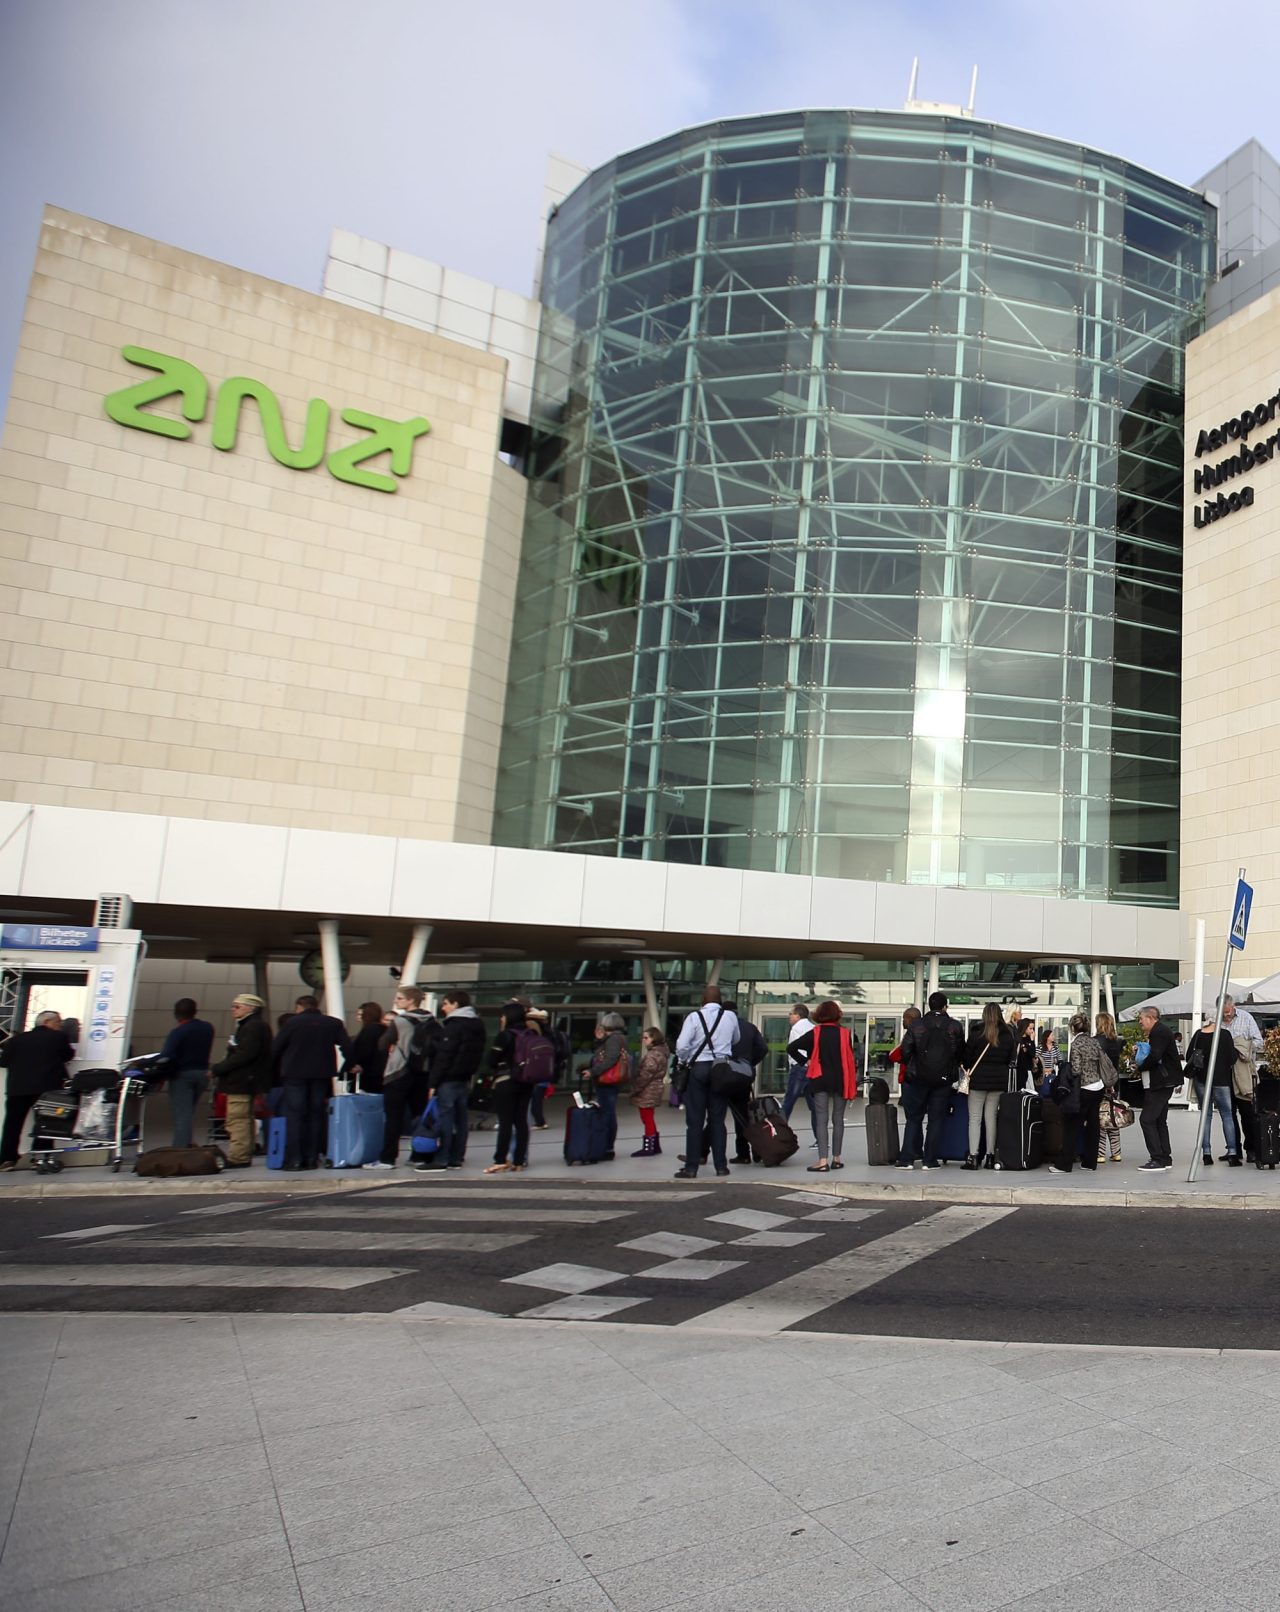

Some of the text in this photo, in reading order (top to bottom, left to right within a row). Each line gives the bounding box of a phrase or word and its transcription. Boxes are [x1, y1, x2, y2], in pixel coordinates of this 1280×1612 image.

[1194, 486, 1255, 529] Lisboa
[40, 927, 88, 938] Bilhetes
[40, 936, 82, 947] Tickets
